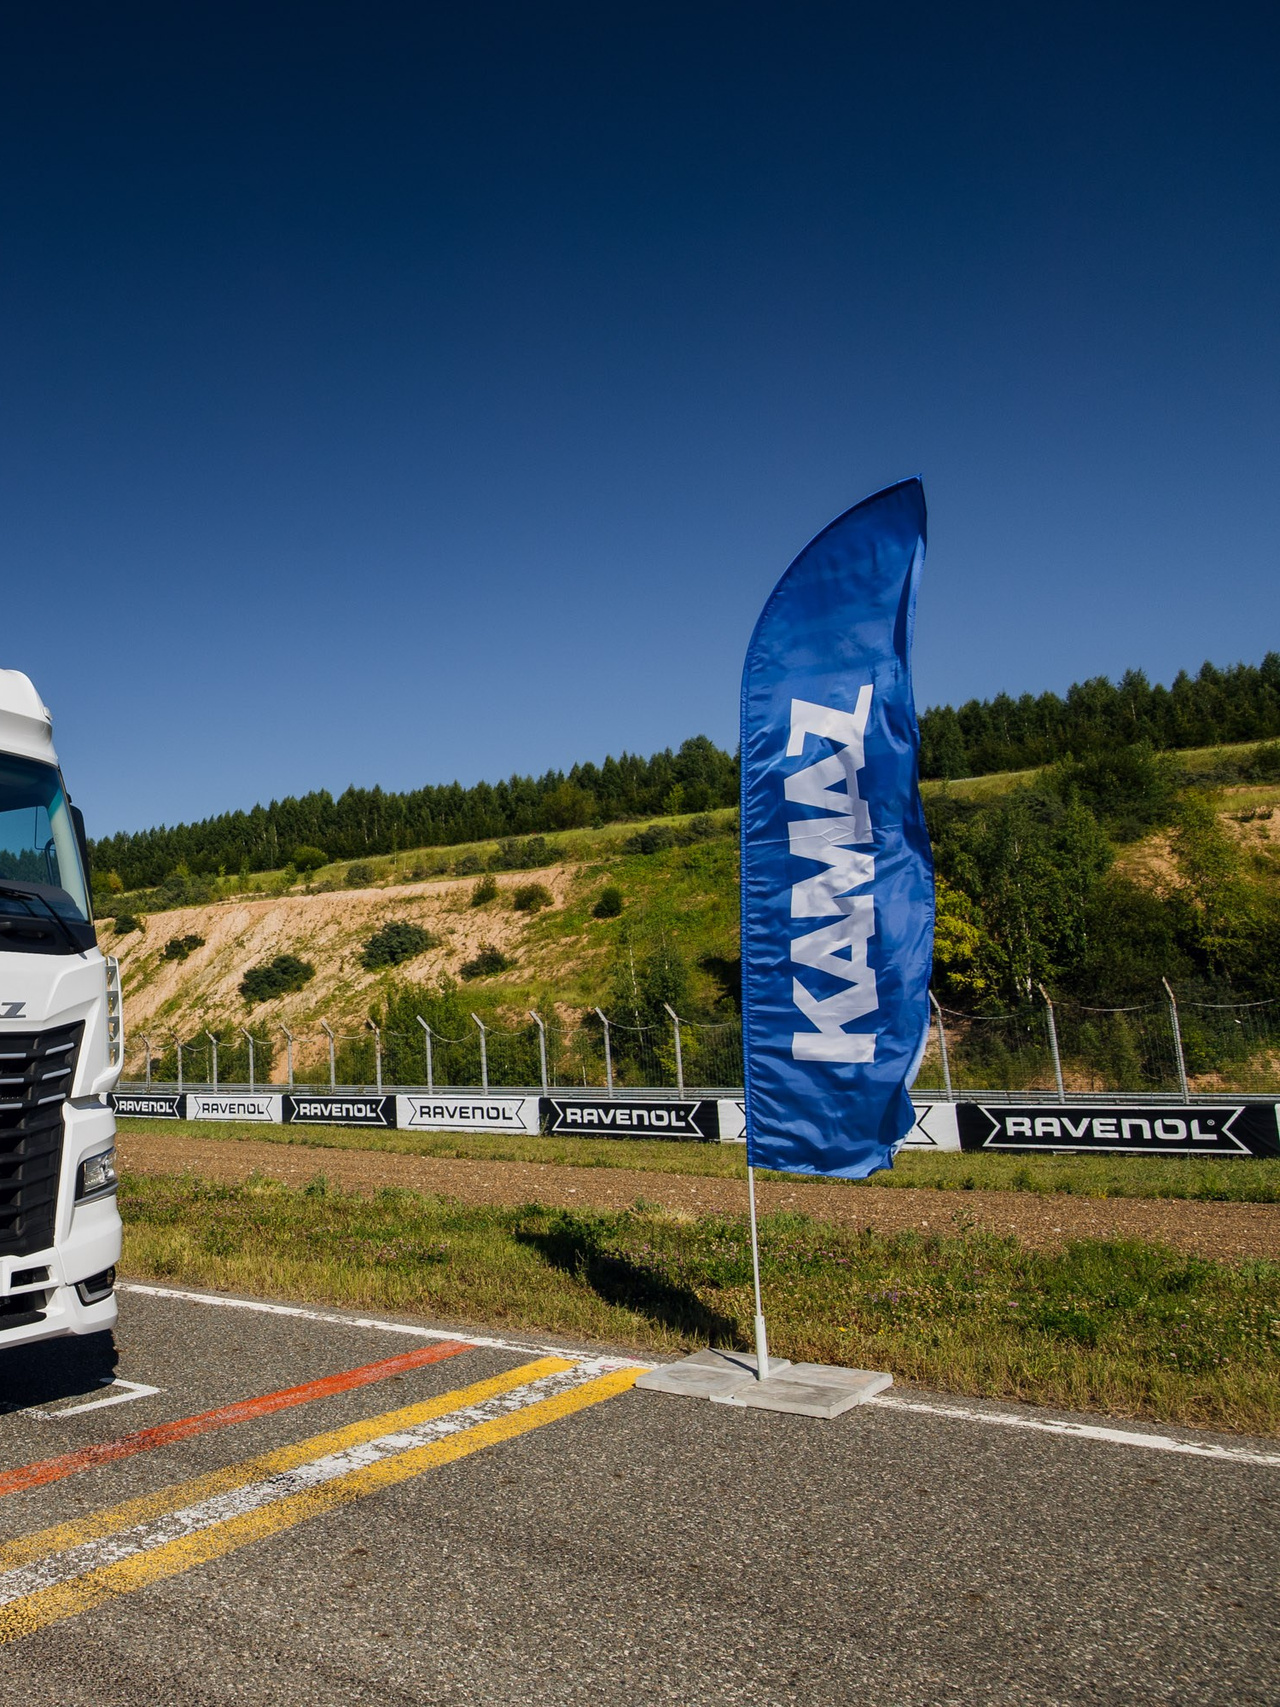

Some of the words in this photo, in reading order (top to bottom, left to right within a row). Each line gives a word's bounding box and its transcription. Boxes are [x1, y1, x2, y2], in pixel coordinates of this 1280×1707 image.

[783, 683, 880, 1064] KAMAZ
[119, 1100, 174, 1113] RAVENOL
[202, 1103, 265, 1115] RAVENOL
[299, 1103, 377, 1117] RAVENOL
[419, 1105, 513, 1121] RAVENOL
[566, 1107, 686, 1127] RAVENOL
